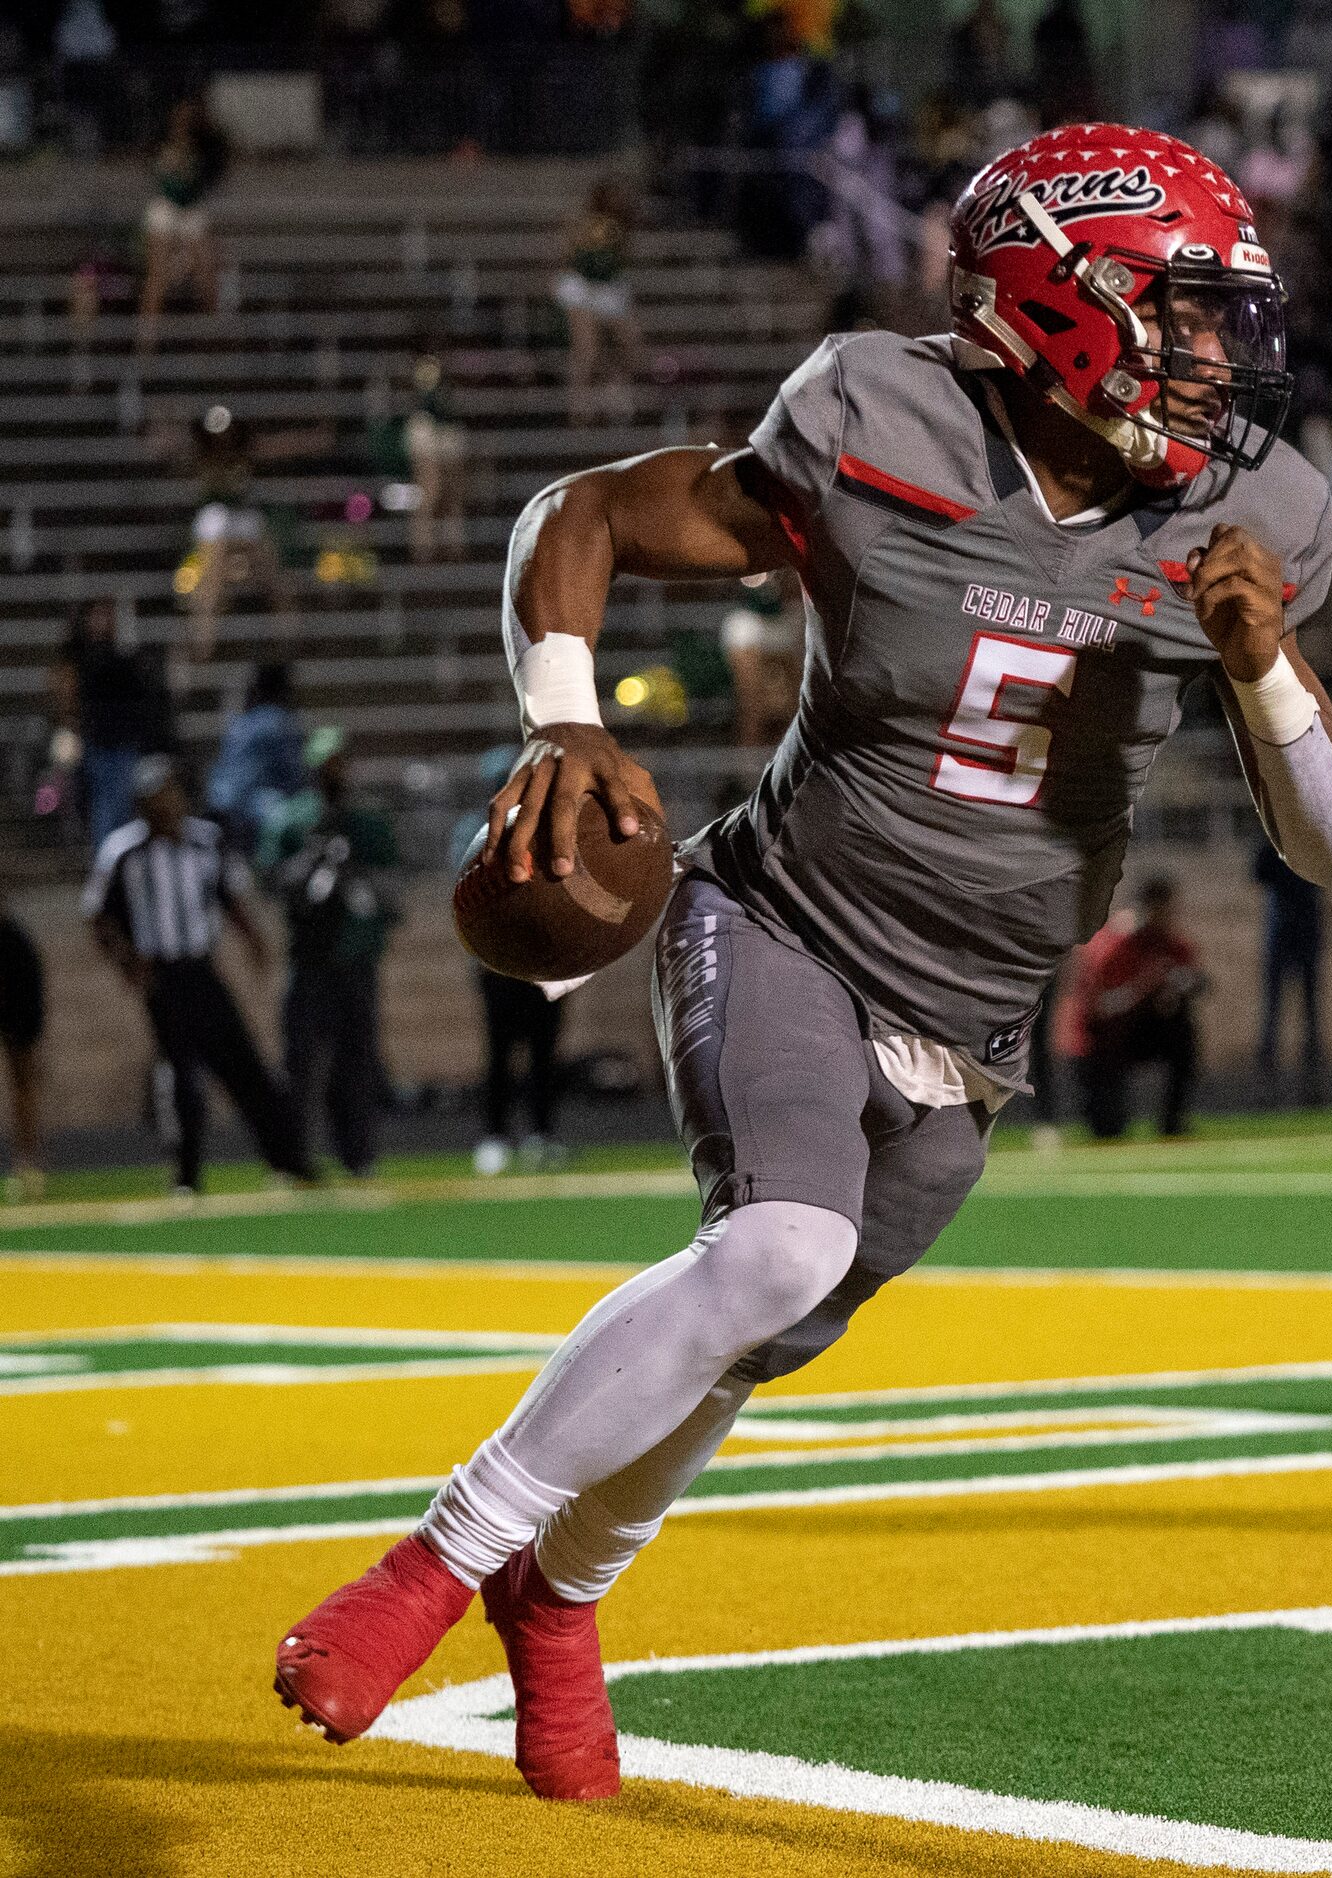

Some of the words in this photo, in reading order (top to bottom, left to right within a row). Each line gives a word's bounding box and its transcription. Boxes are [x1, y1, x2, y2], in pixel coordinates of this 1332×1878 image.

[963, 166, 1165, 256] Horns
[962, 584, 1051, 632] CEDAR
[1057, 607, 1117, 652] HILL
[929, 630, 1078, 810] 5
